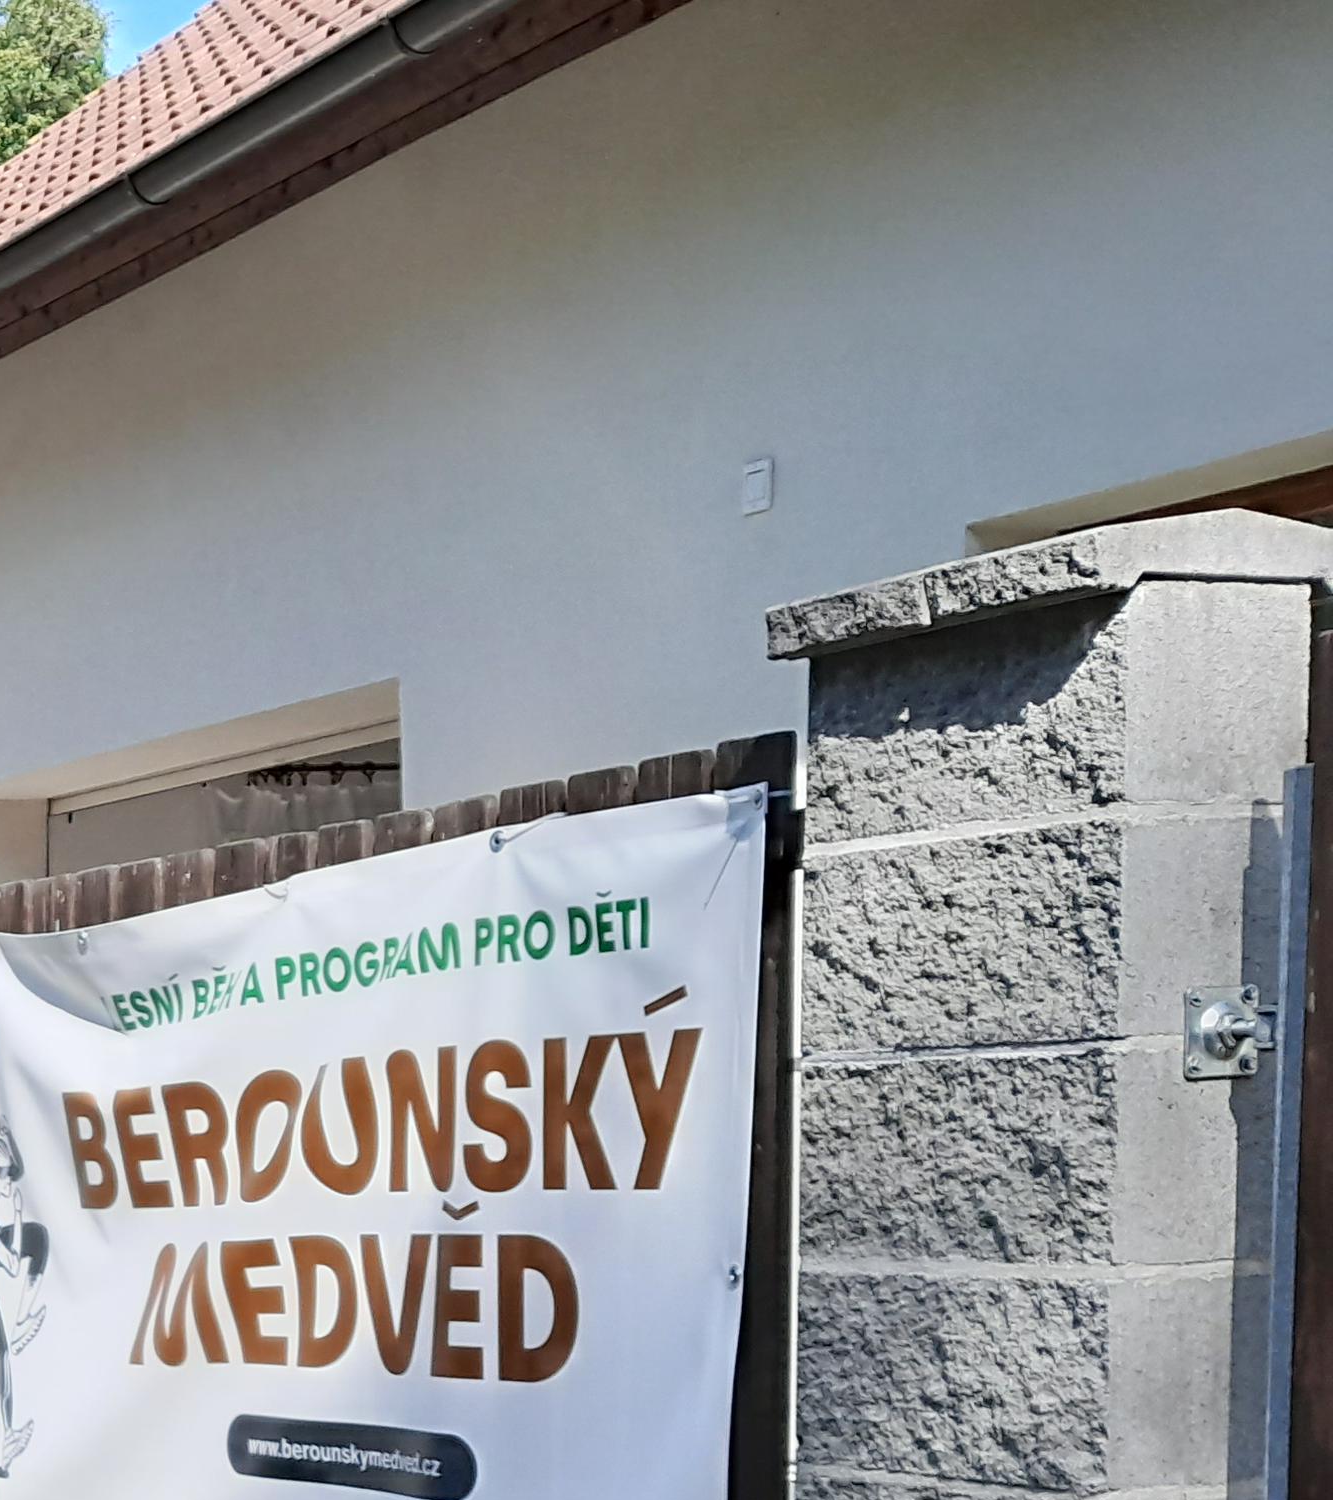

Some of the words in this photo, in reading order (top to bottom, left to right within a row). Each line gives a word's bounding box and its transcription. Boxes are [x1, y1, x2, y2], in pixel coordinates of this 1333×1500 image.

[240, 961, 265, 1006] A
[275, 921, 461, 1001] PROGRAM
[474, 910, 555, 966] PRO
[567, 891, 651, 957] DĚTI
[62, 985, 703, 1210] BEROUNSKÝ
[130, 1200, 579, 1382] MEDVĚD
[247, 1437, 442, 1477] www.berounskymedved.cz
